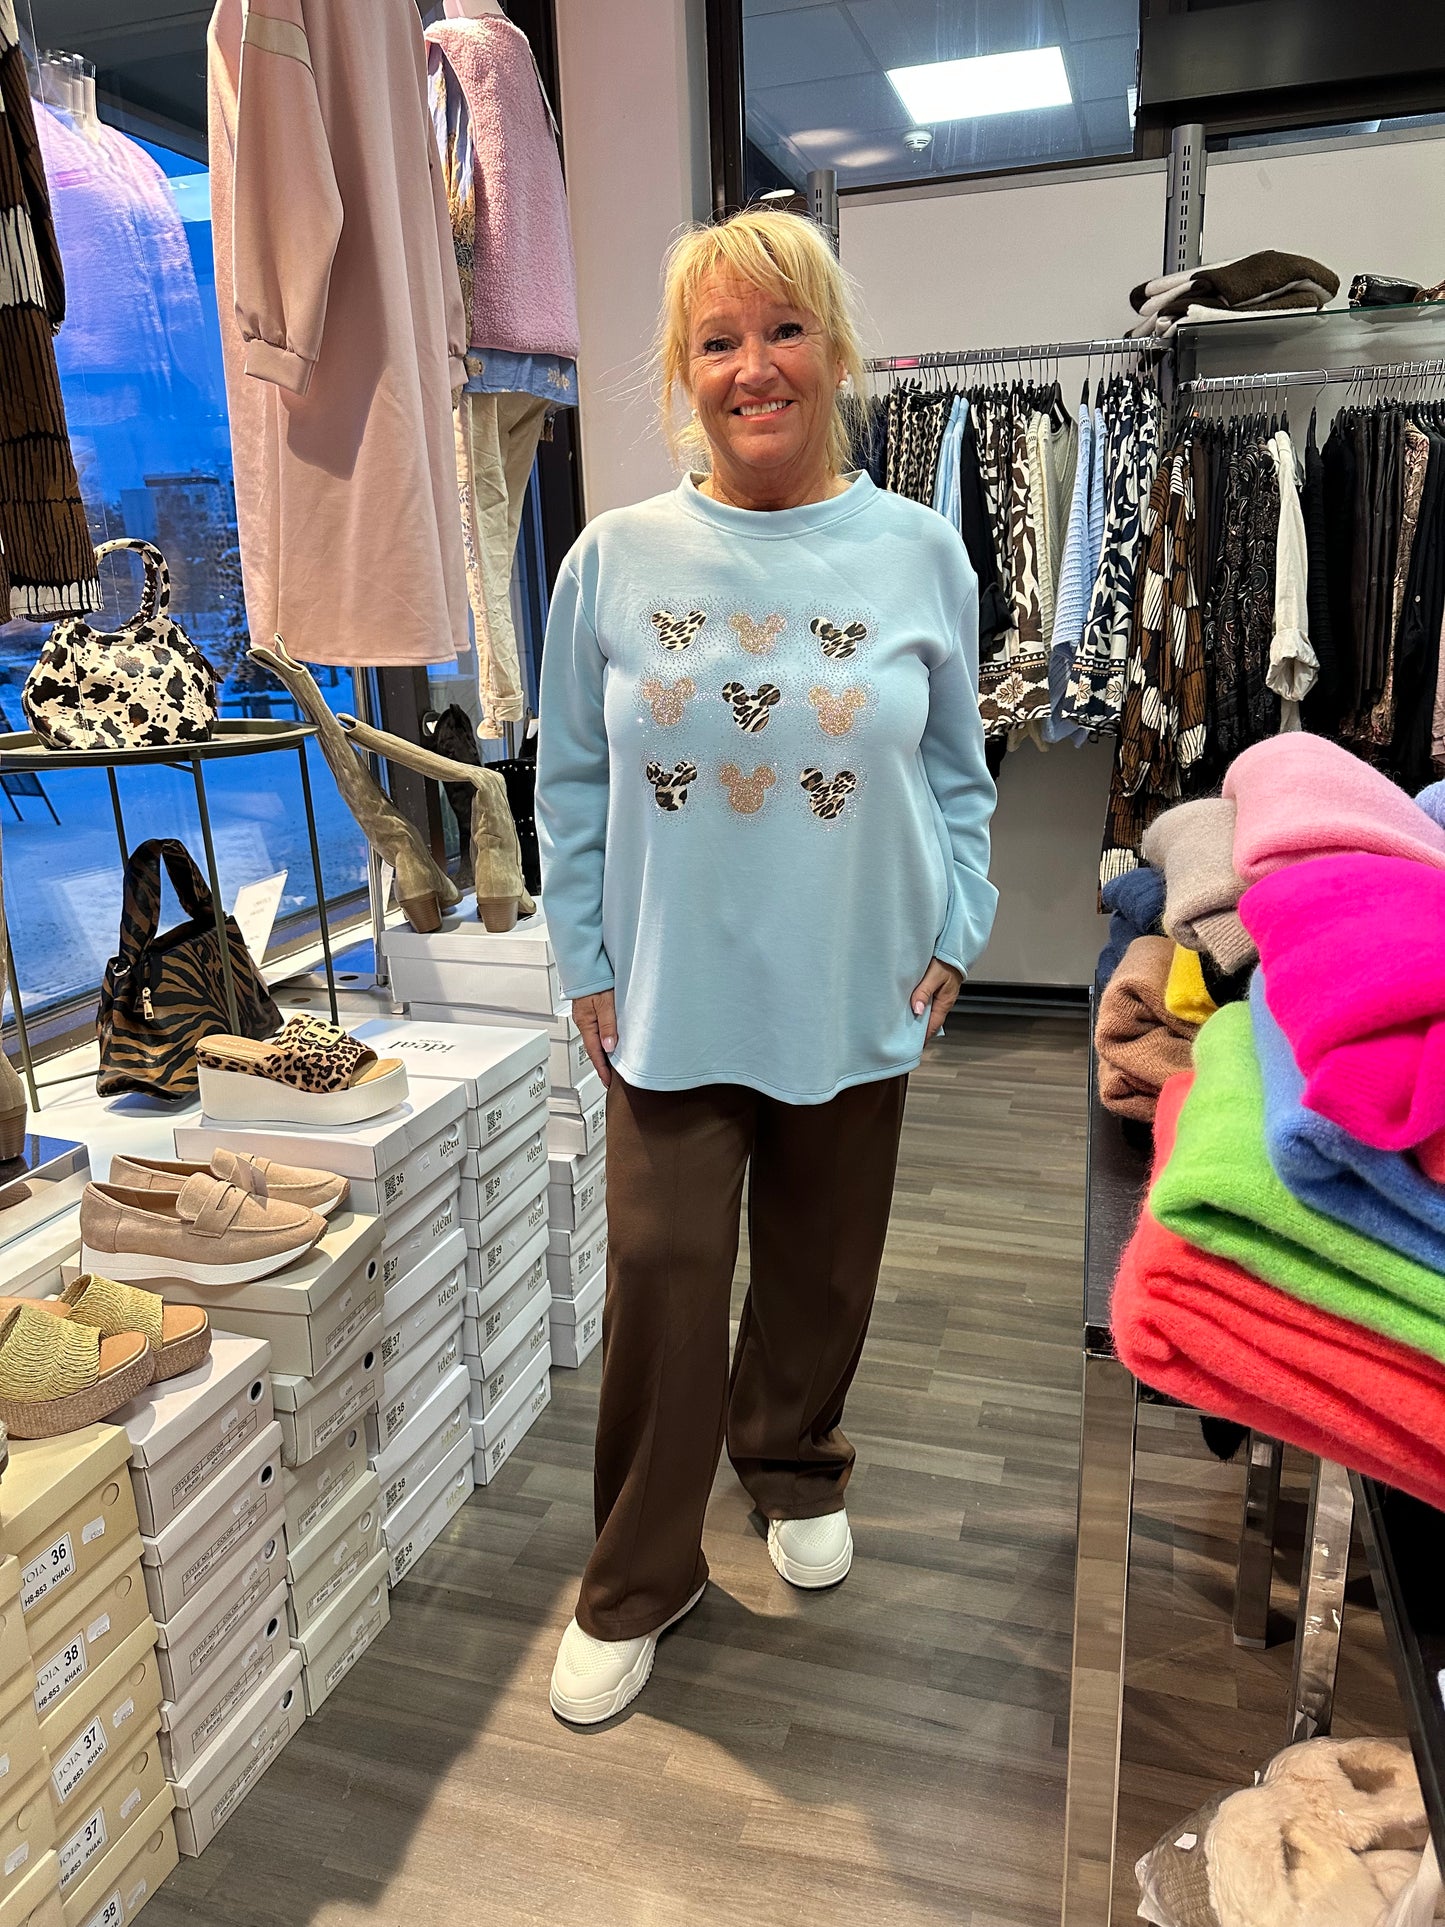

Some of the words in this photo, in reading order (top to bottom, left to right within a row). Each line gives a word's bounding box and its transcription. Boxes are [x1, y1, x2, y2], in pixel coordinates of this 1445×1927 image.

[529, 1078, 546, 1097] ideal
[395, 1172, 404, 1187] 36
[432, 1212, 452, 1237] ideal
[390, 1256, 399, 1271] 37
[438, 1282, 459, 1307] ideal
[392, 1331, 401, 1347] 37
[51, 1543, 67, 1566] 36
[51, 1564, 71, 1584] KHAKI
[64, 1644, 79, 1667] 38
[64, 1663, 83, 1685] KHAKI
[58, 1752, 81, 1781] JOIA
[83, 1726, 97, 1750] 37
[87, 1743, 104, 1765] KHAKI
[84, 1818, 98, 1842] 37
[86, 1837, 103, 1859] KHAKI
[102, 1901, 117, 1924] 38
